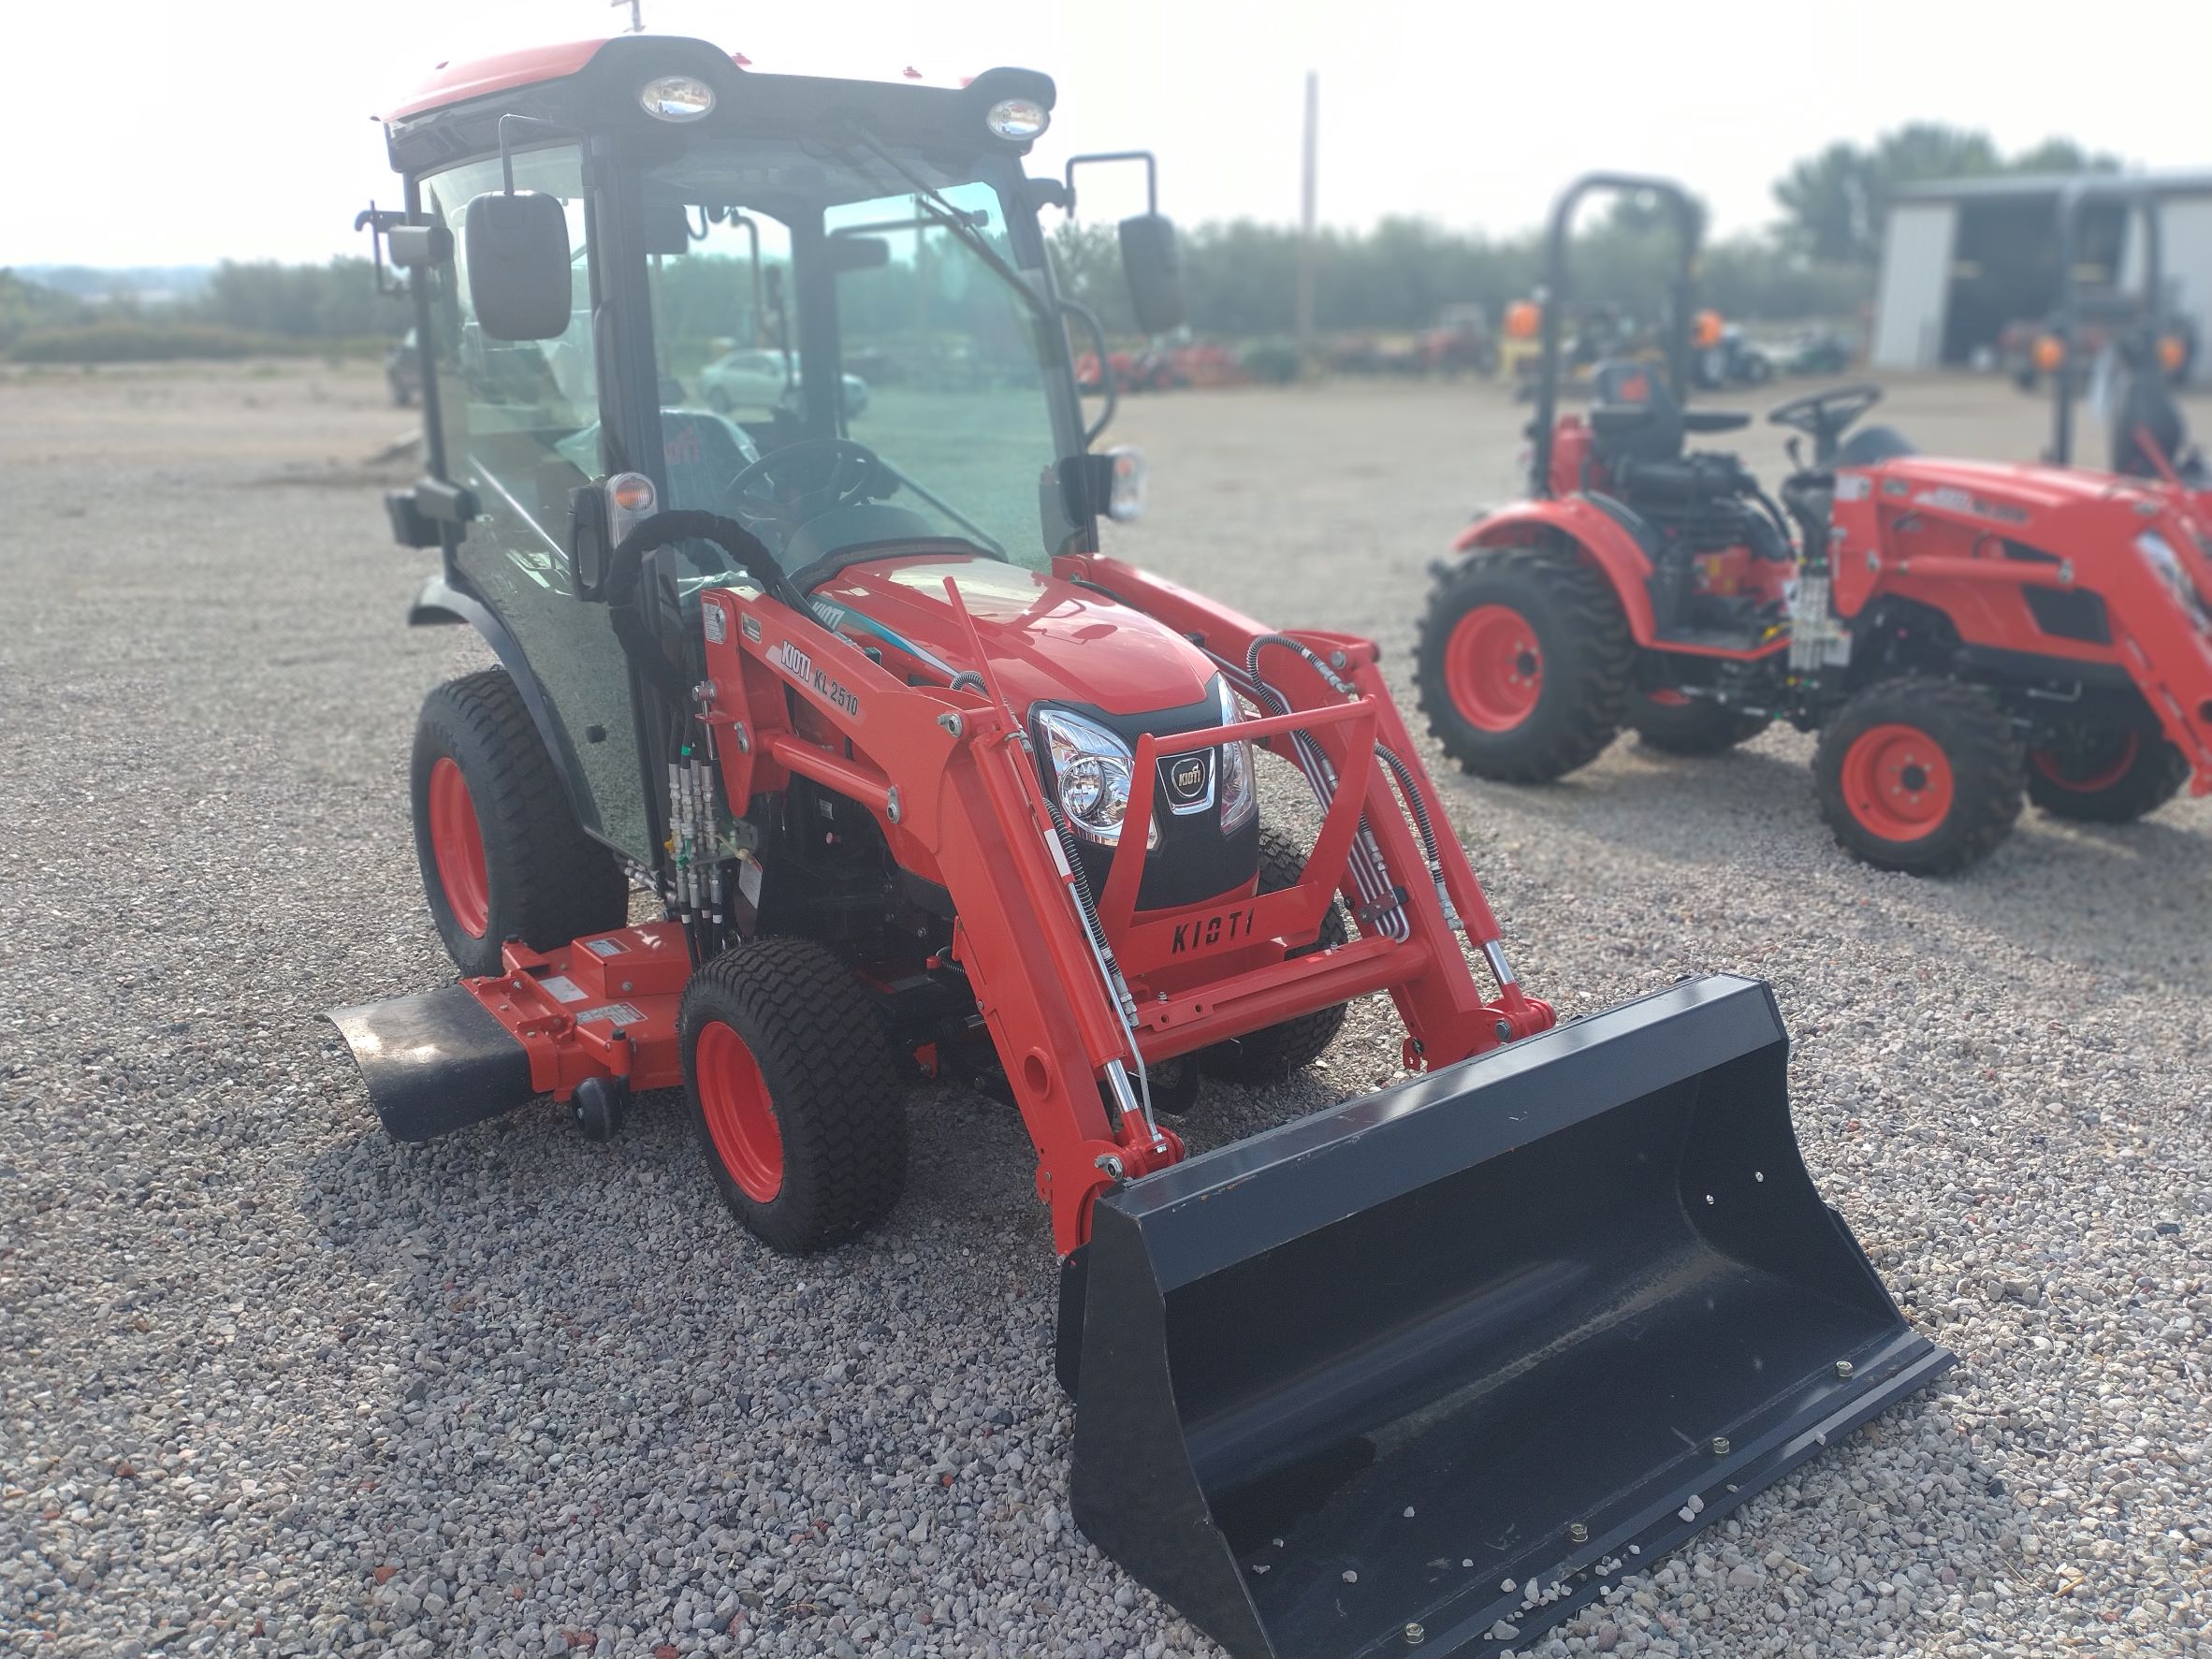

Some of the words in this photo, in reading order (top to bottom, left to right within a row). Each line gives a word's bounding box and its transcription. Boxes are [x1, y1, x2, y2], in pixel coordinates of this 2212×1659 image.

[781, 640, 811, 682] KIOTI
[813, 669, 828, 695] KL
[830, 680, 859, 716] 2510
[1179, 769, 1201, 787] KIOTI
[1171, 908, 1255, 954] KIOTI
